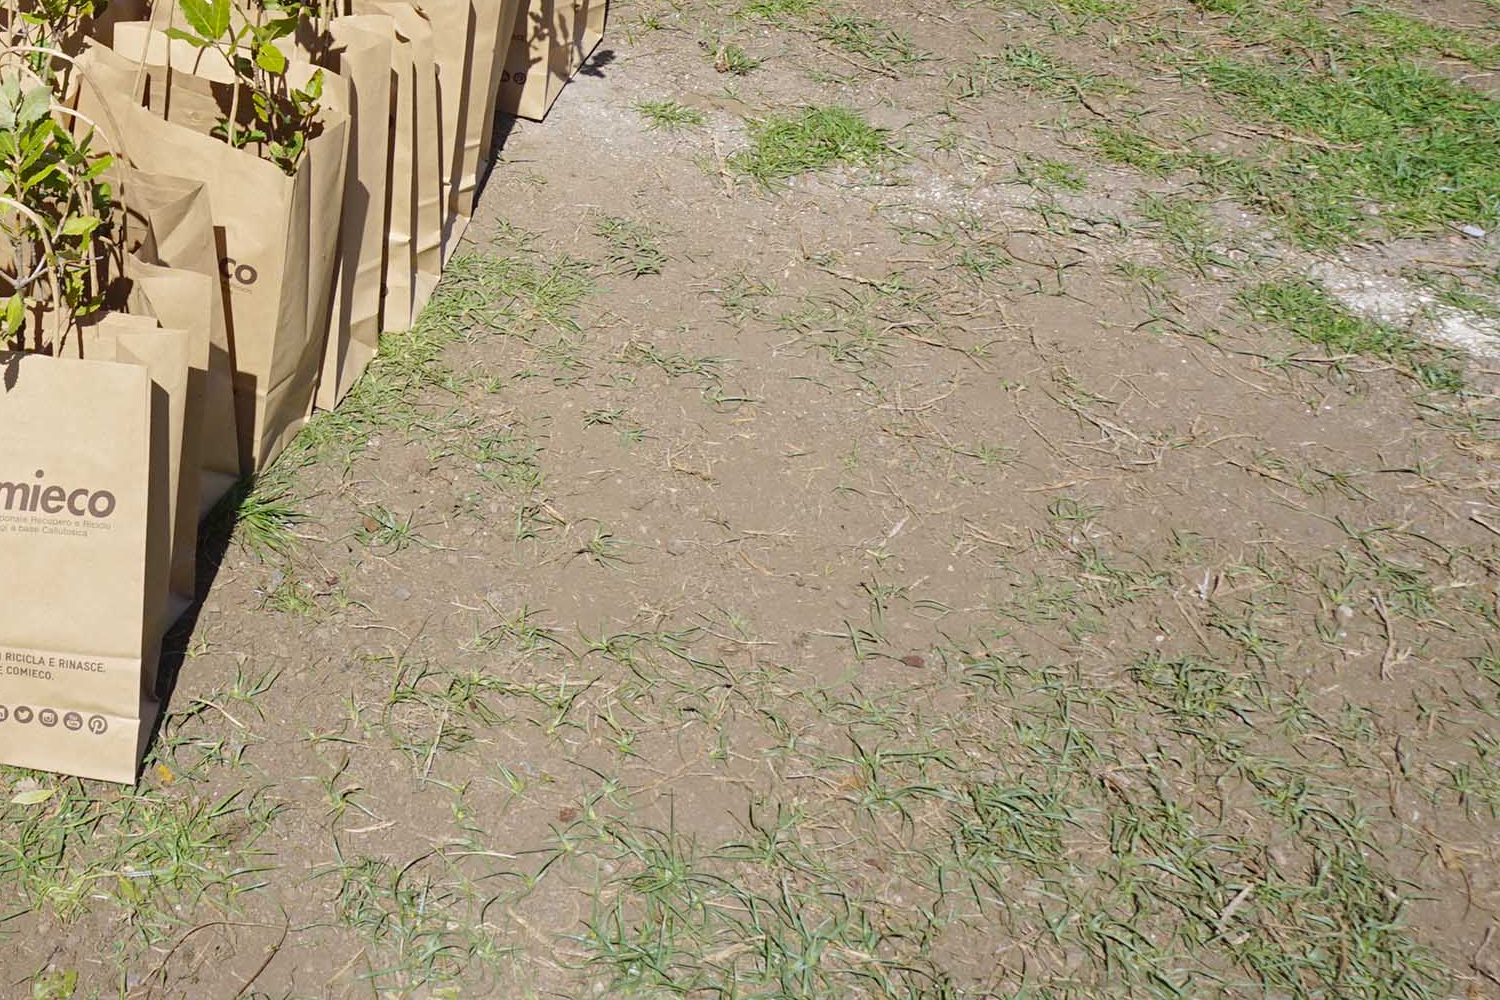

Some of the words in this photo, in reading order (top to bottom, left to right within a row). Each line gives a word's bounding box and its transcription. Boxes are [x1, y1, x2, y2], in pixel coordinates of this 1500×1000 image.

[5, 652, 46, 666] RICICLA
[49, 657, 55, 667] E
[58, 658, 106, 673] RINASCE.
[6, 666, 54, 681] COMIECO.
